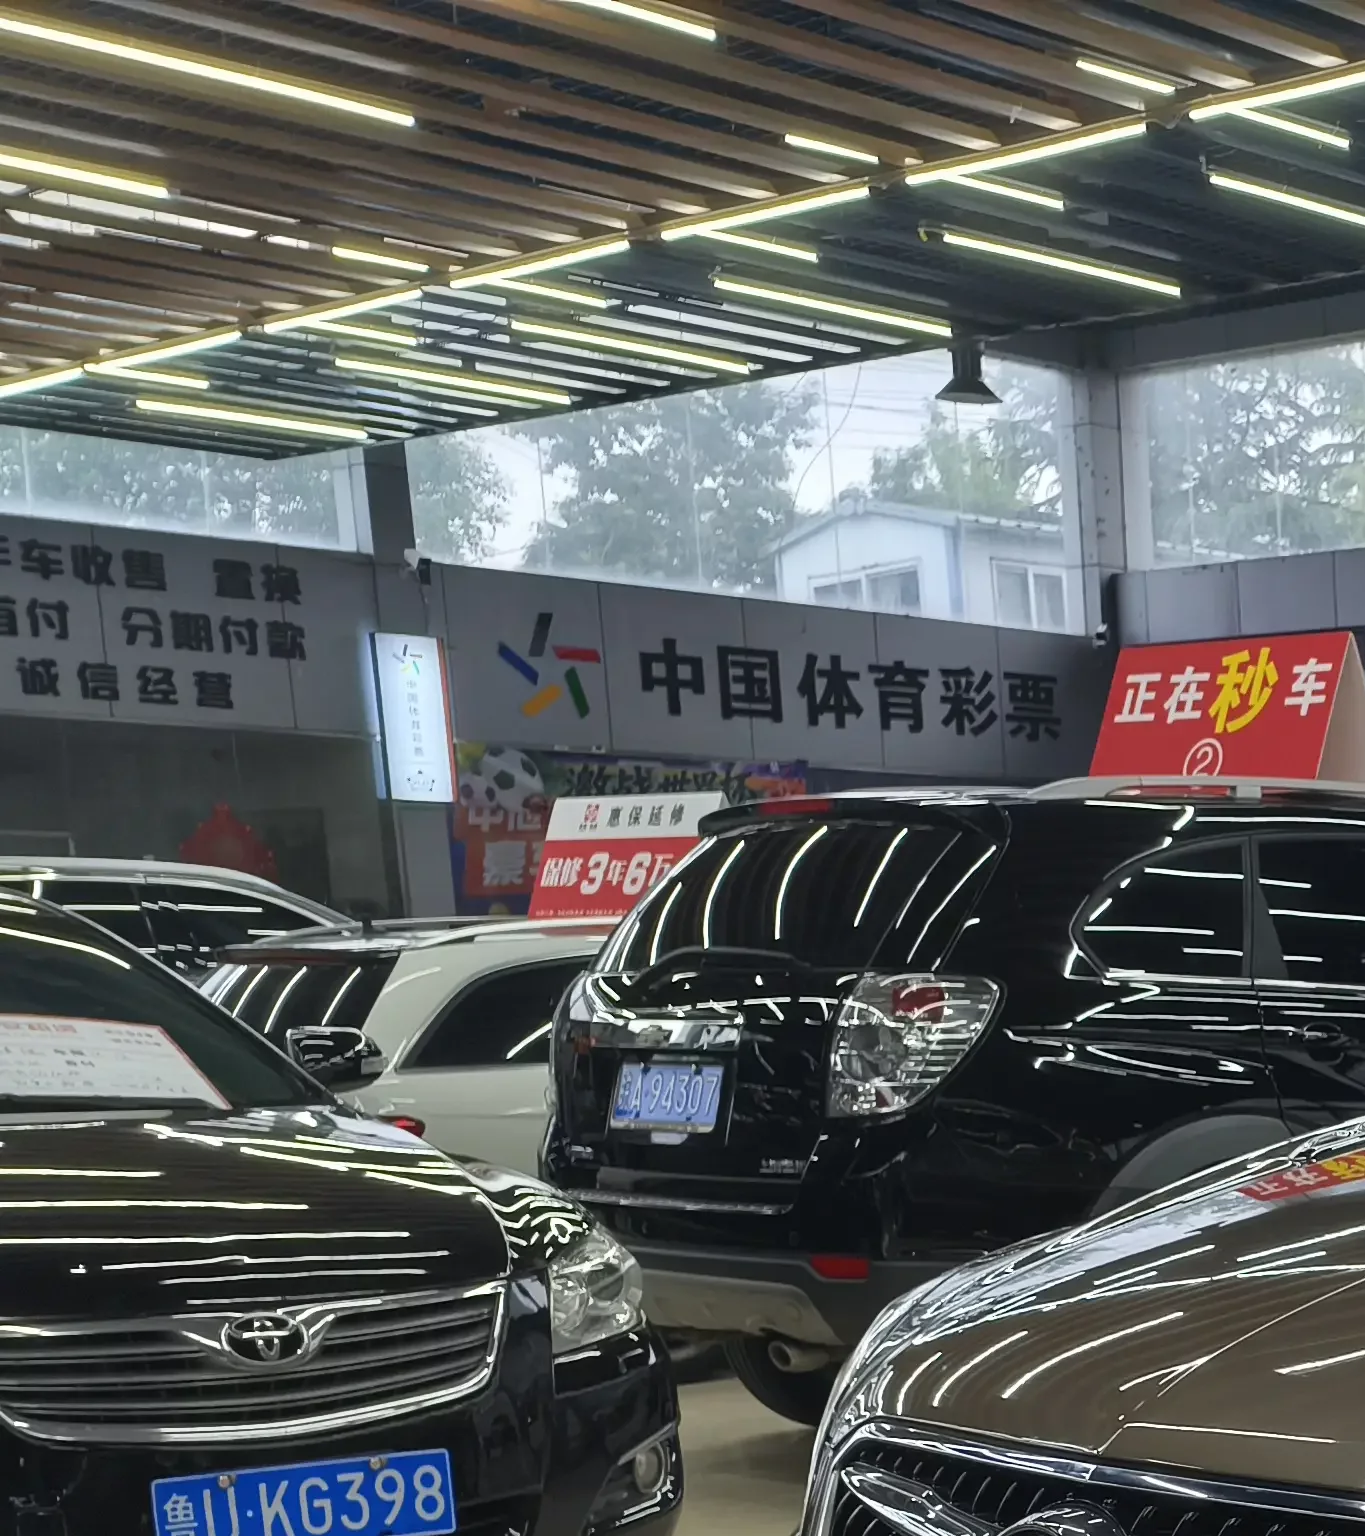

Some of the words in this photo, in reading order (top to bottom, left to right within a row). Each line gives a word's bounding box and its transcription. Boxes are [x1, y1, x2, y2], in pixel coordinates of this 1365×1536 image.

[121, 606, 307, 661] 分期付款
[16, 656, 234, 709] 诚信经营
[639, 637, 1063, 744] 中国体育彩票
[1113, 646, 1333, 734] 正在秒车
